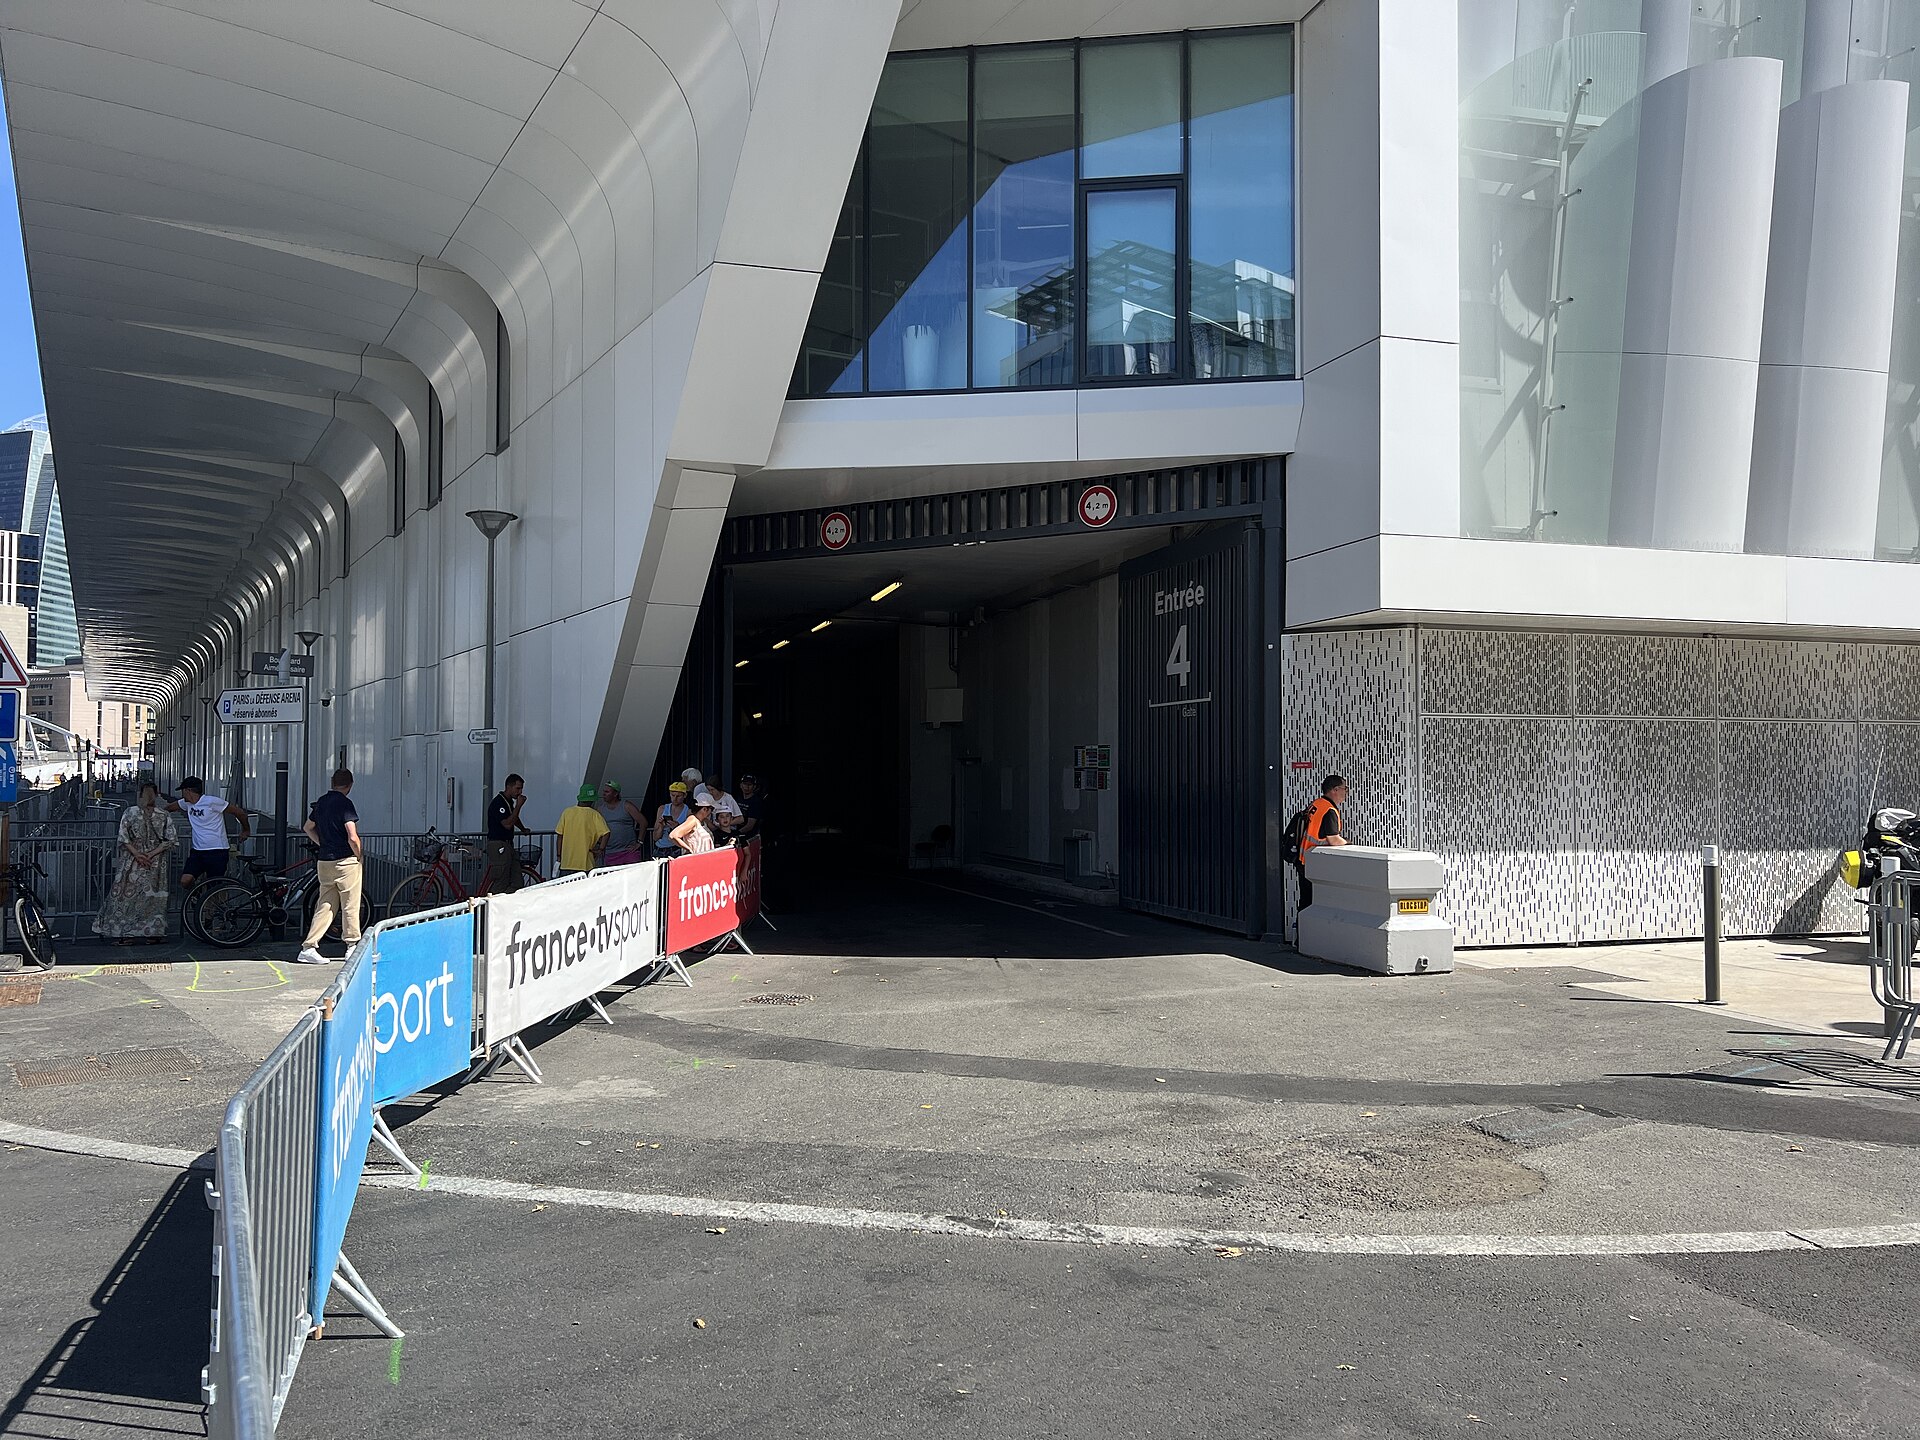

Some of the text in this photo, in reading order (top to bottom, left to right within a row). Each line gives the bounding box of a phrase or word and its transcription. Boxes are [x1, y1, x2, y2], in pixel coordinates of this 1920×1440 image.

[1086, 501, 1100, 511] 4,2
[1155, 580, 1205, 616] Entrée
[1166, 624, 1191, 687] 4
[232, 694, 250, 705] PARIS
[255, 691, 281, 705] DÉFENSE
[281, 692, 301, 704] ARENA
[254, 707, 278, 719] abonnés
